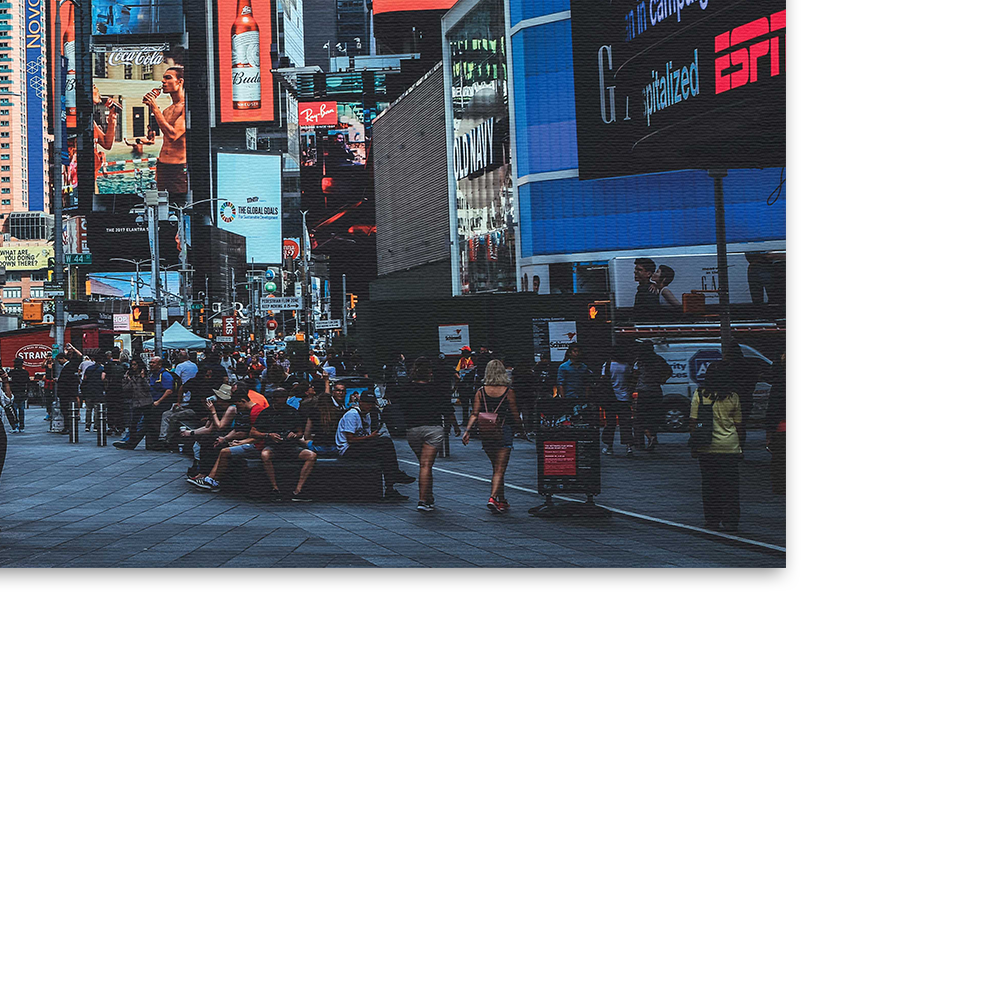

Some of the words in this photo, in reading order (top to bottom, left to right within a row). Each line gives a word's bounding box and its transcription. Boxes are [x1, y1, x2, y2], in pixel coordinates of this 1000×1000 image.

[643, 48, 700, 126] pitalized
[300, 103, 335, 123] Ray-Ban
[453, 132, 468, 180] OLD
[470, 117, 494, 174] NAVY
[238, 206, 246, 215] THE
[247, 206, 263, 215] GLOBAL
[264, 206, 279, 215] GOALS
